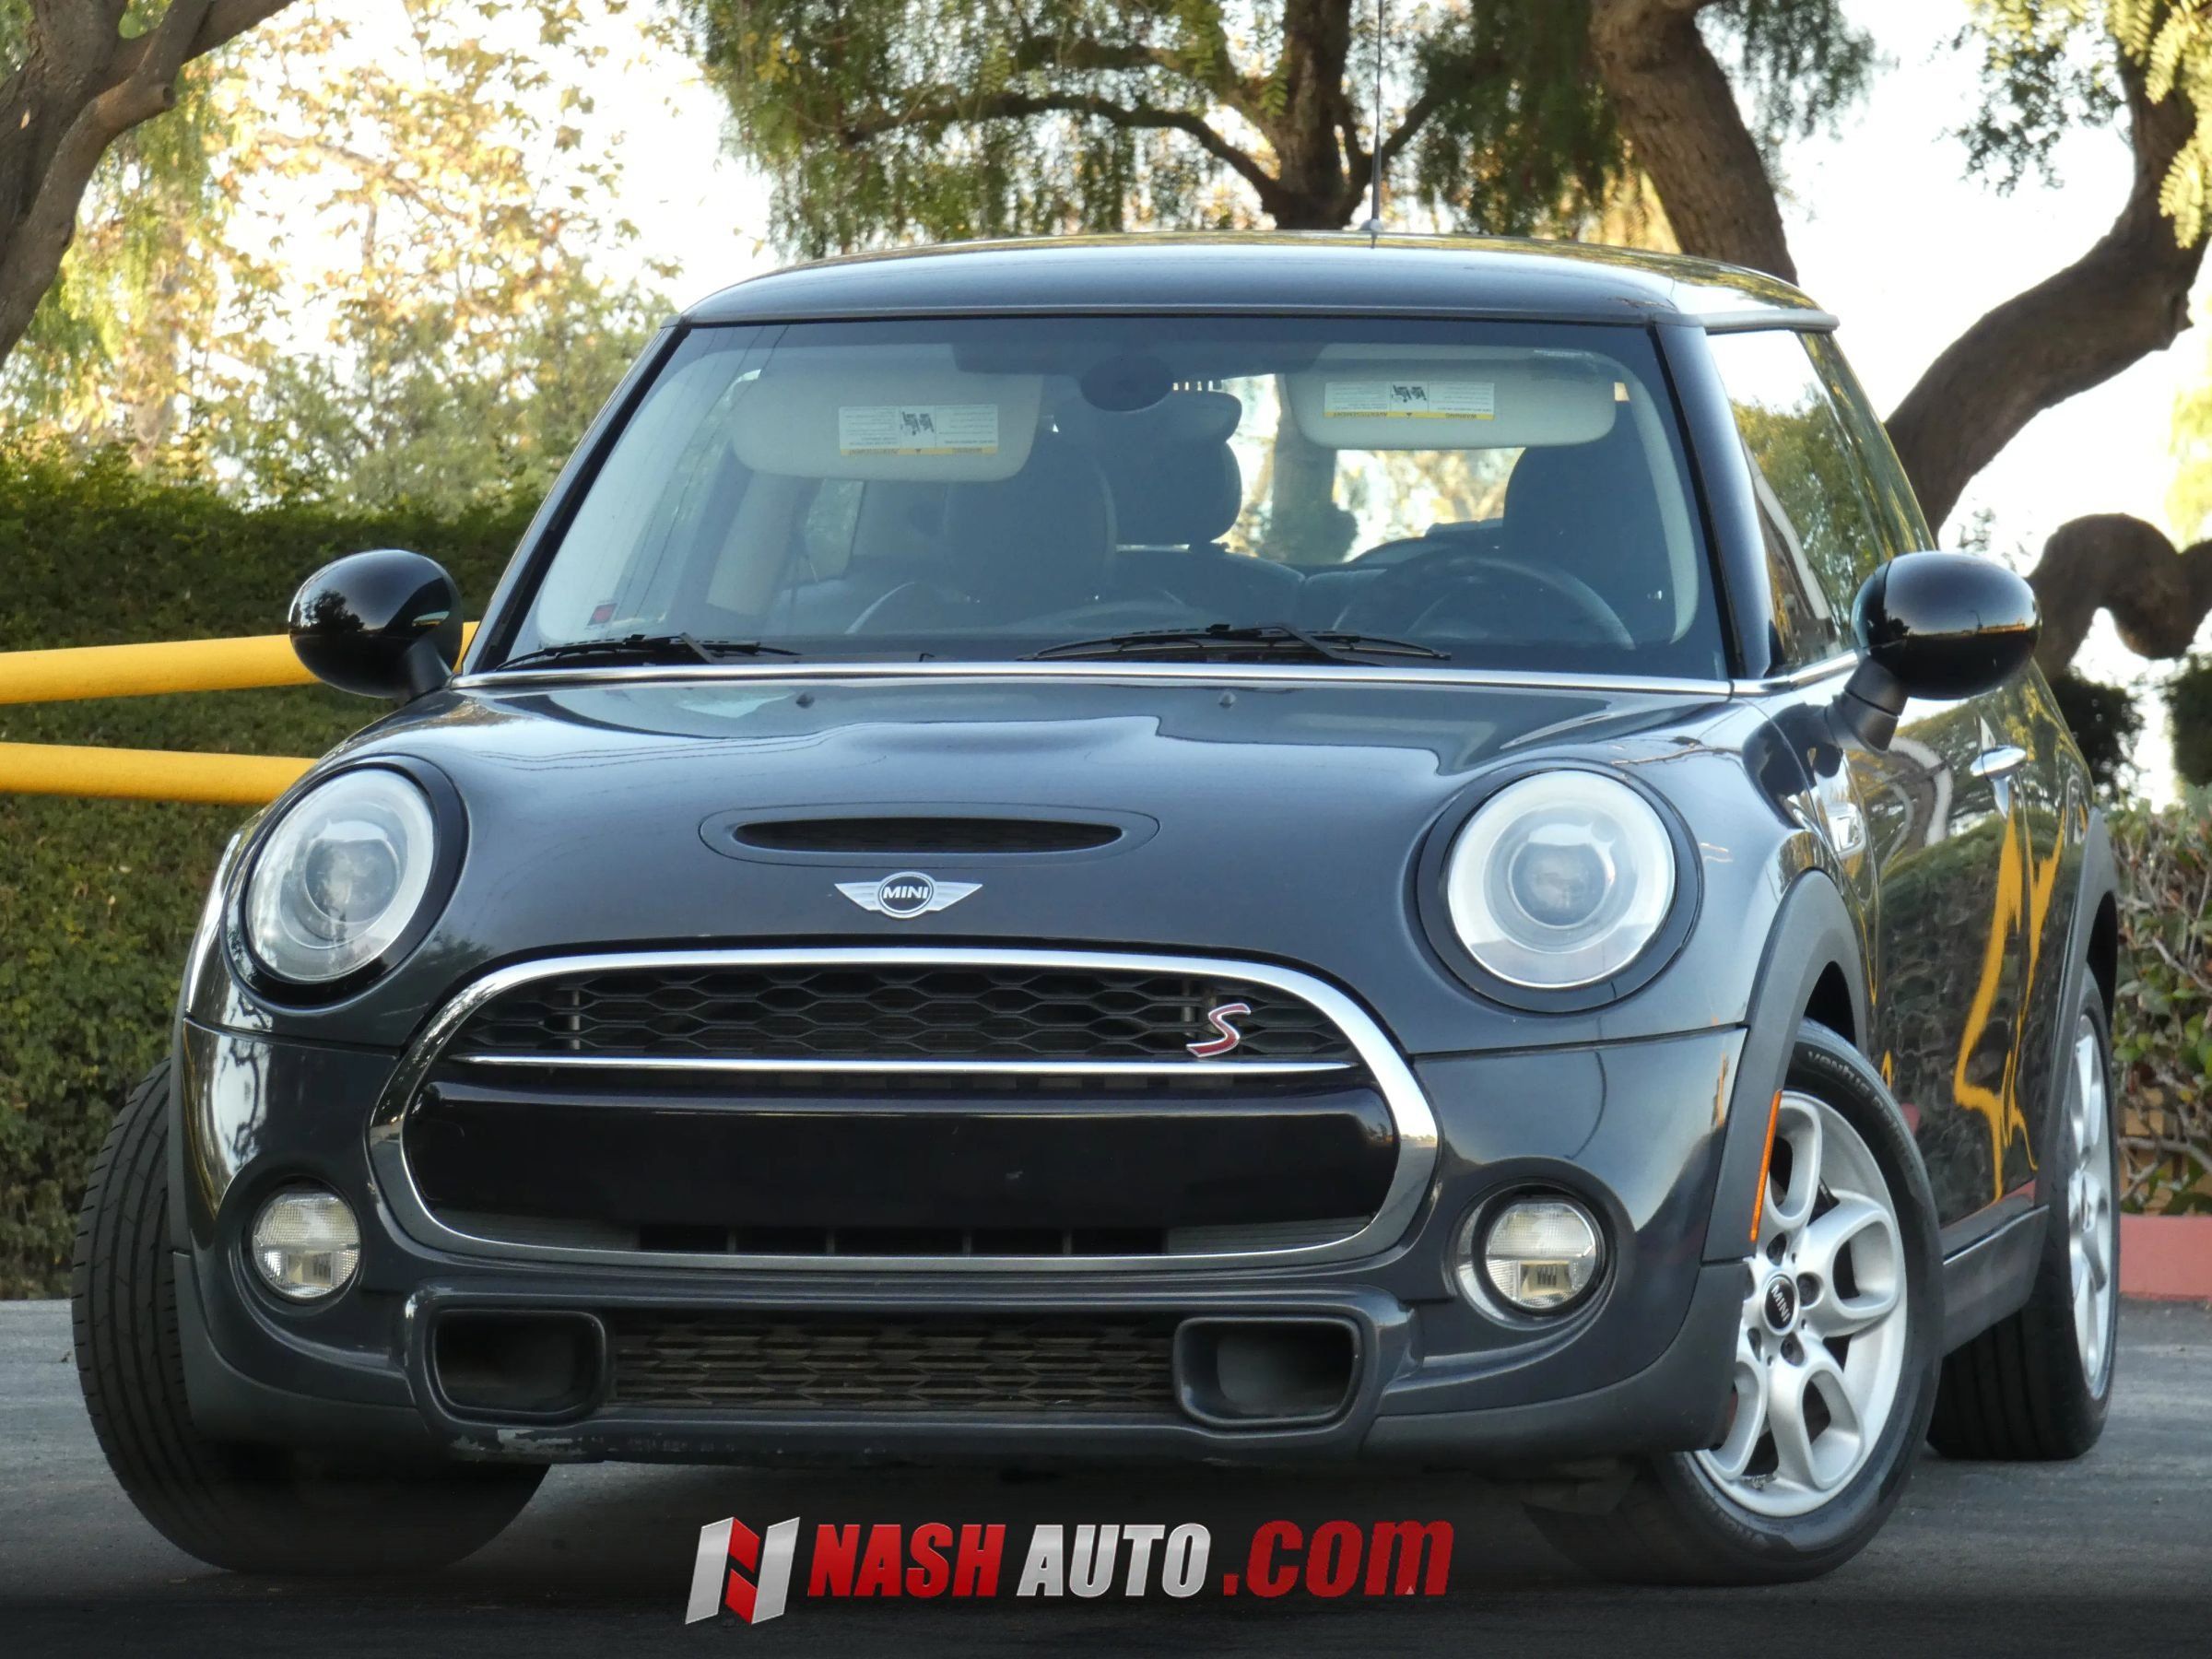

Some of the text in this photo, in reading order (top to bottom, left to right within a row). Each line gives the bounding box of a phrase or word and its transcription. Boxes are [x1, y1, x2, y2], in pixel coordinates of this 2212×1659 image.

[883, 886, 929, 900] MINI
[1186, 1002, 1252, 1058] S
[1771, 1284, 1791, 1323] MINI
